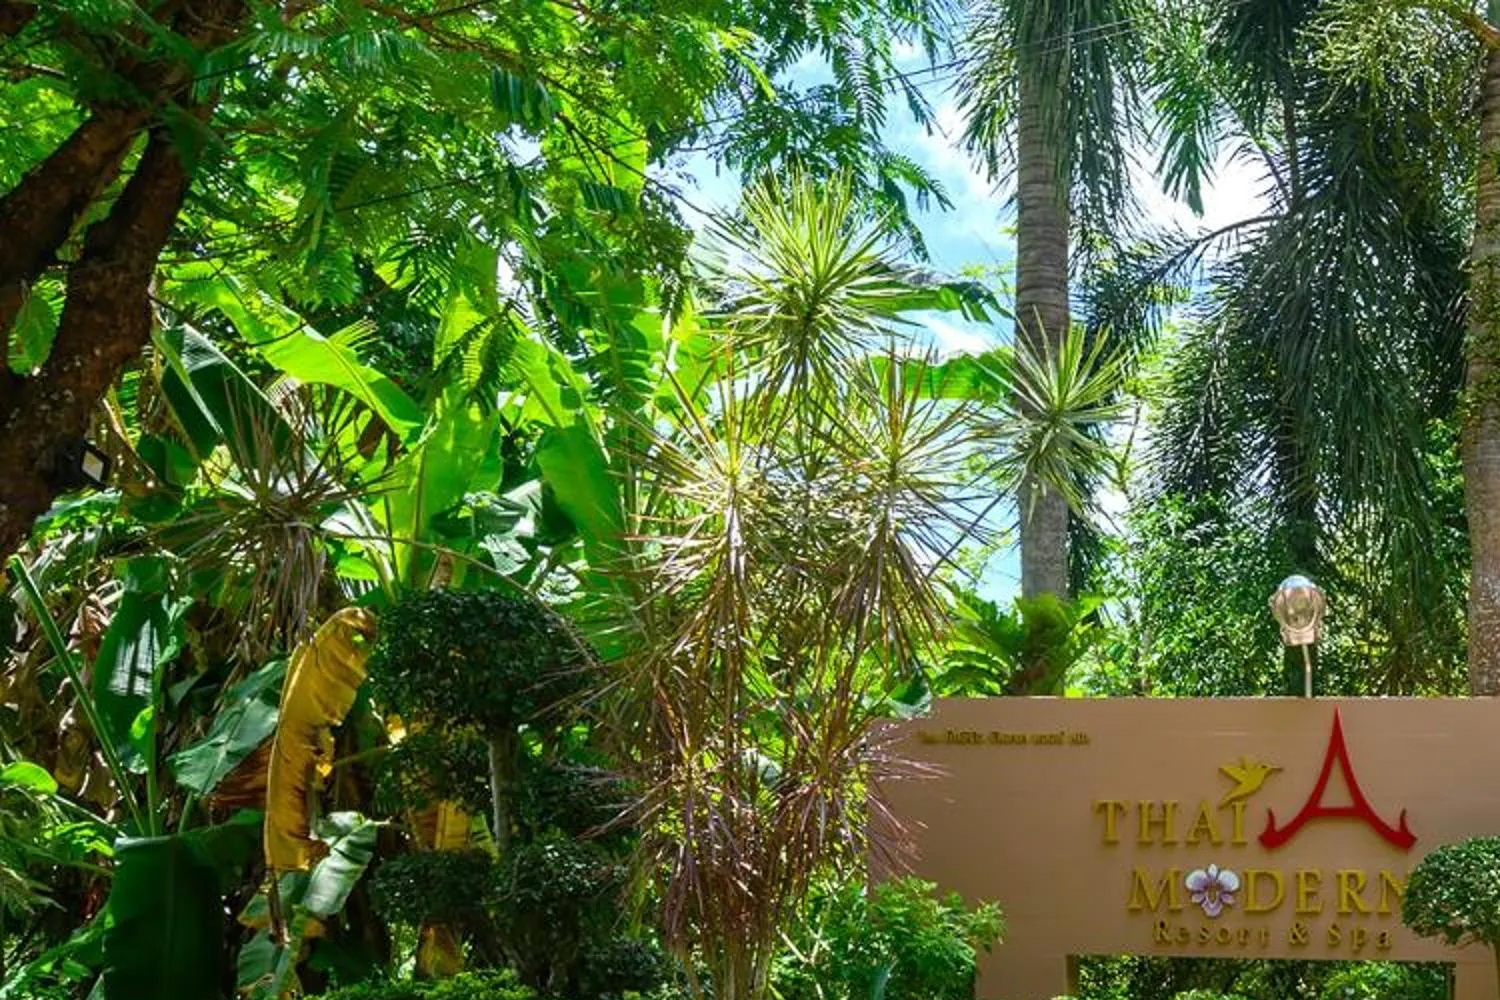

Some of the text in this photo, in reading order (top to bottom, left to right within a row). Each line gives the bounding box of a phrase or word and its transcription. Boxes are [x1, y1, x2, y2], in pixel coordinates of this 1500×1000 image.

[1094, 799, 1249, 846] THAI
[1153, 919, 1393, 951] Resort & Spa
